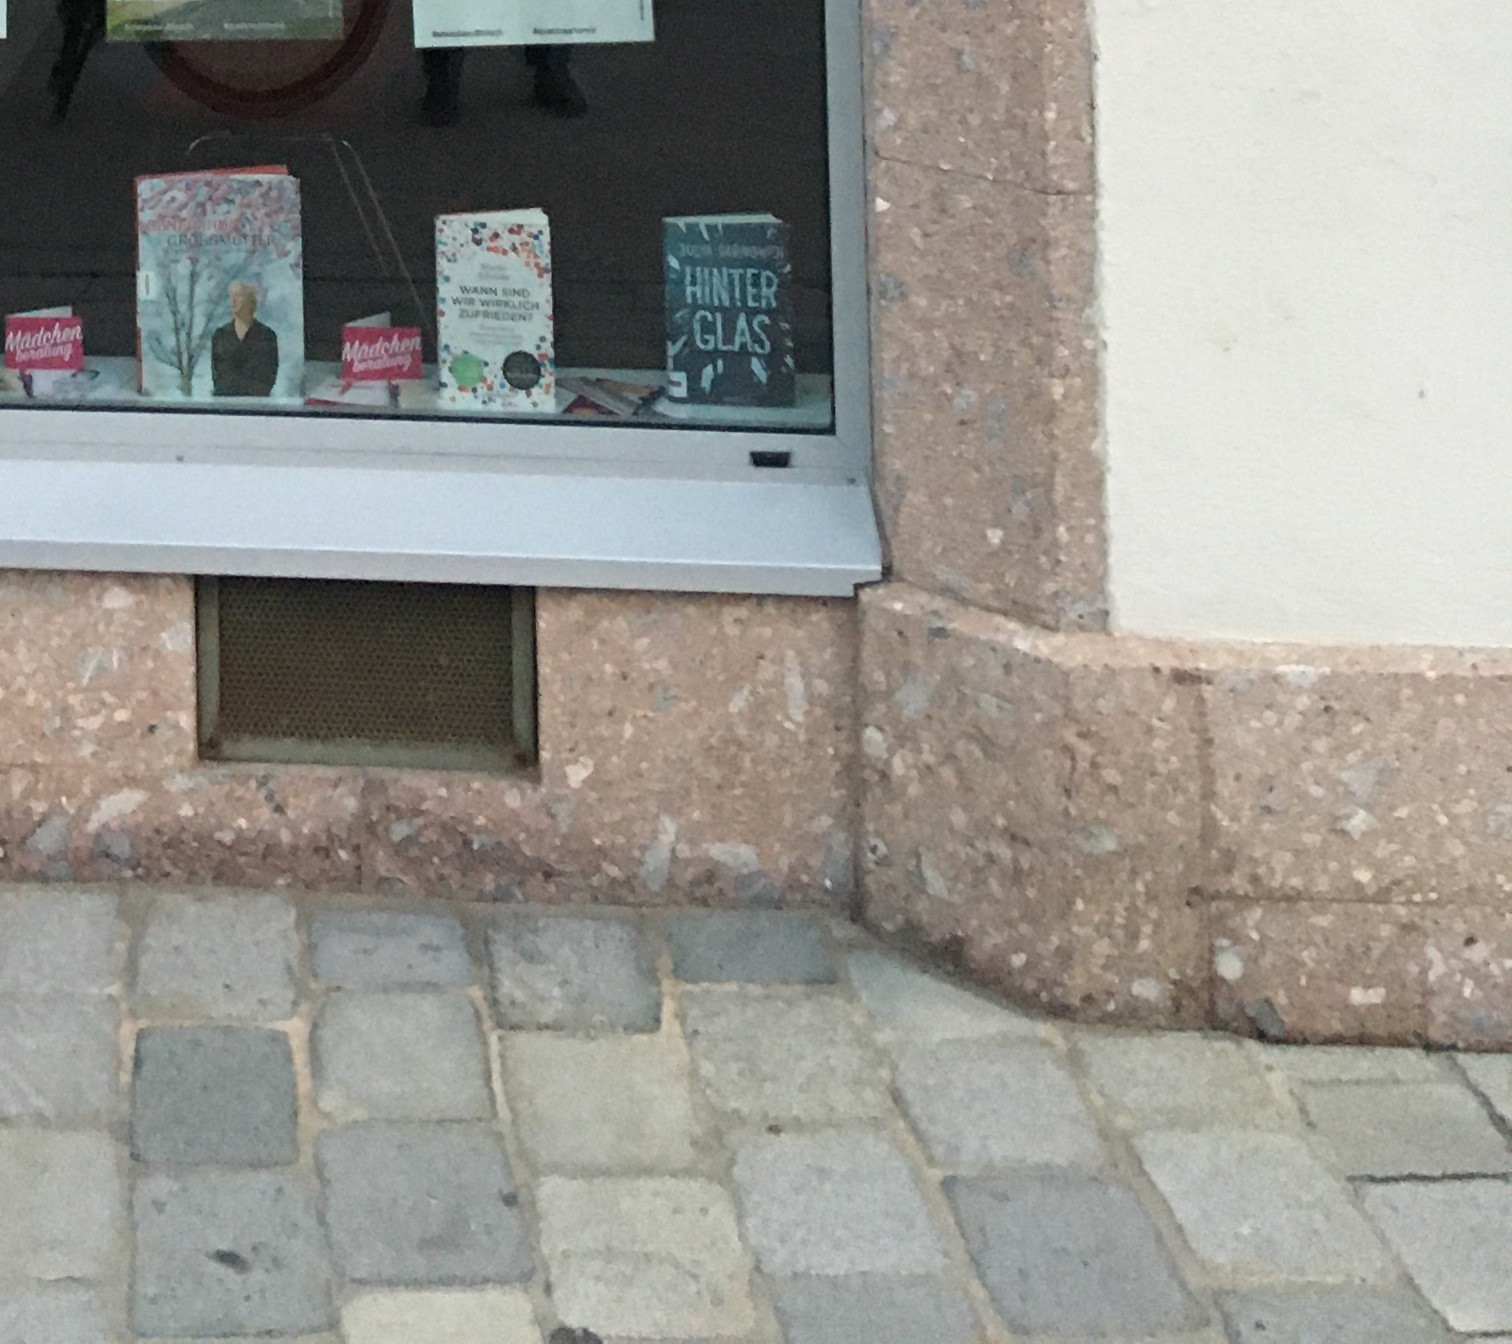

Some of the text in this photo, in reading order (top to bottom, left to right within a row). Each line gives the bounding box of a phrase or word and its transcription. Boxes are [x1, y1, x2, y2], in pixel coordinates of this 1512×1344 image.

[459, 285, 531, 299] WANN SIND
[684, 265, 780, 310] HINTER
[450, 296, 541, 311] WIR WIRKLICH
[692, 309, 773, 355] GLAS
